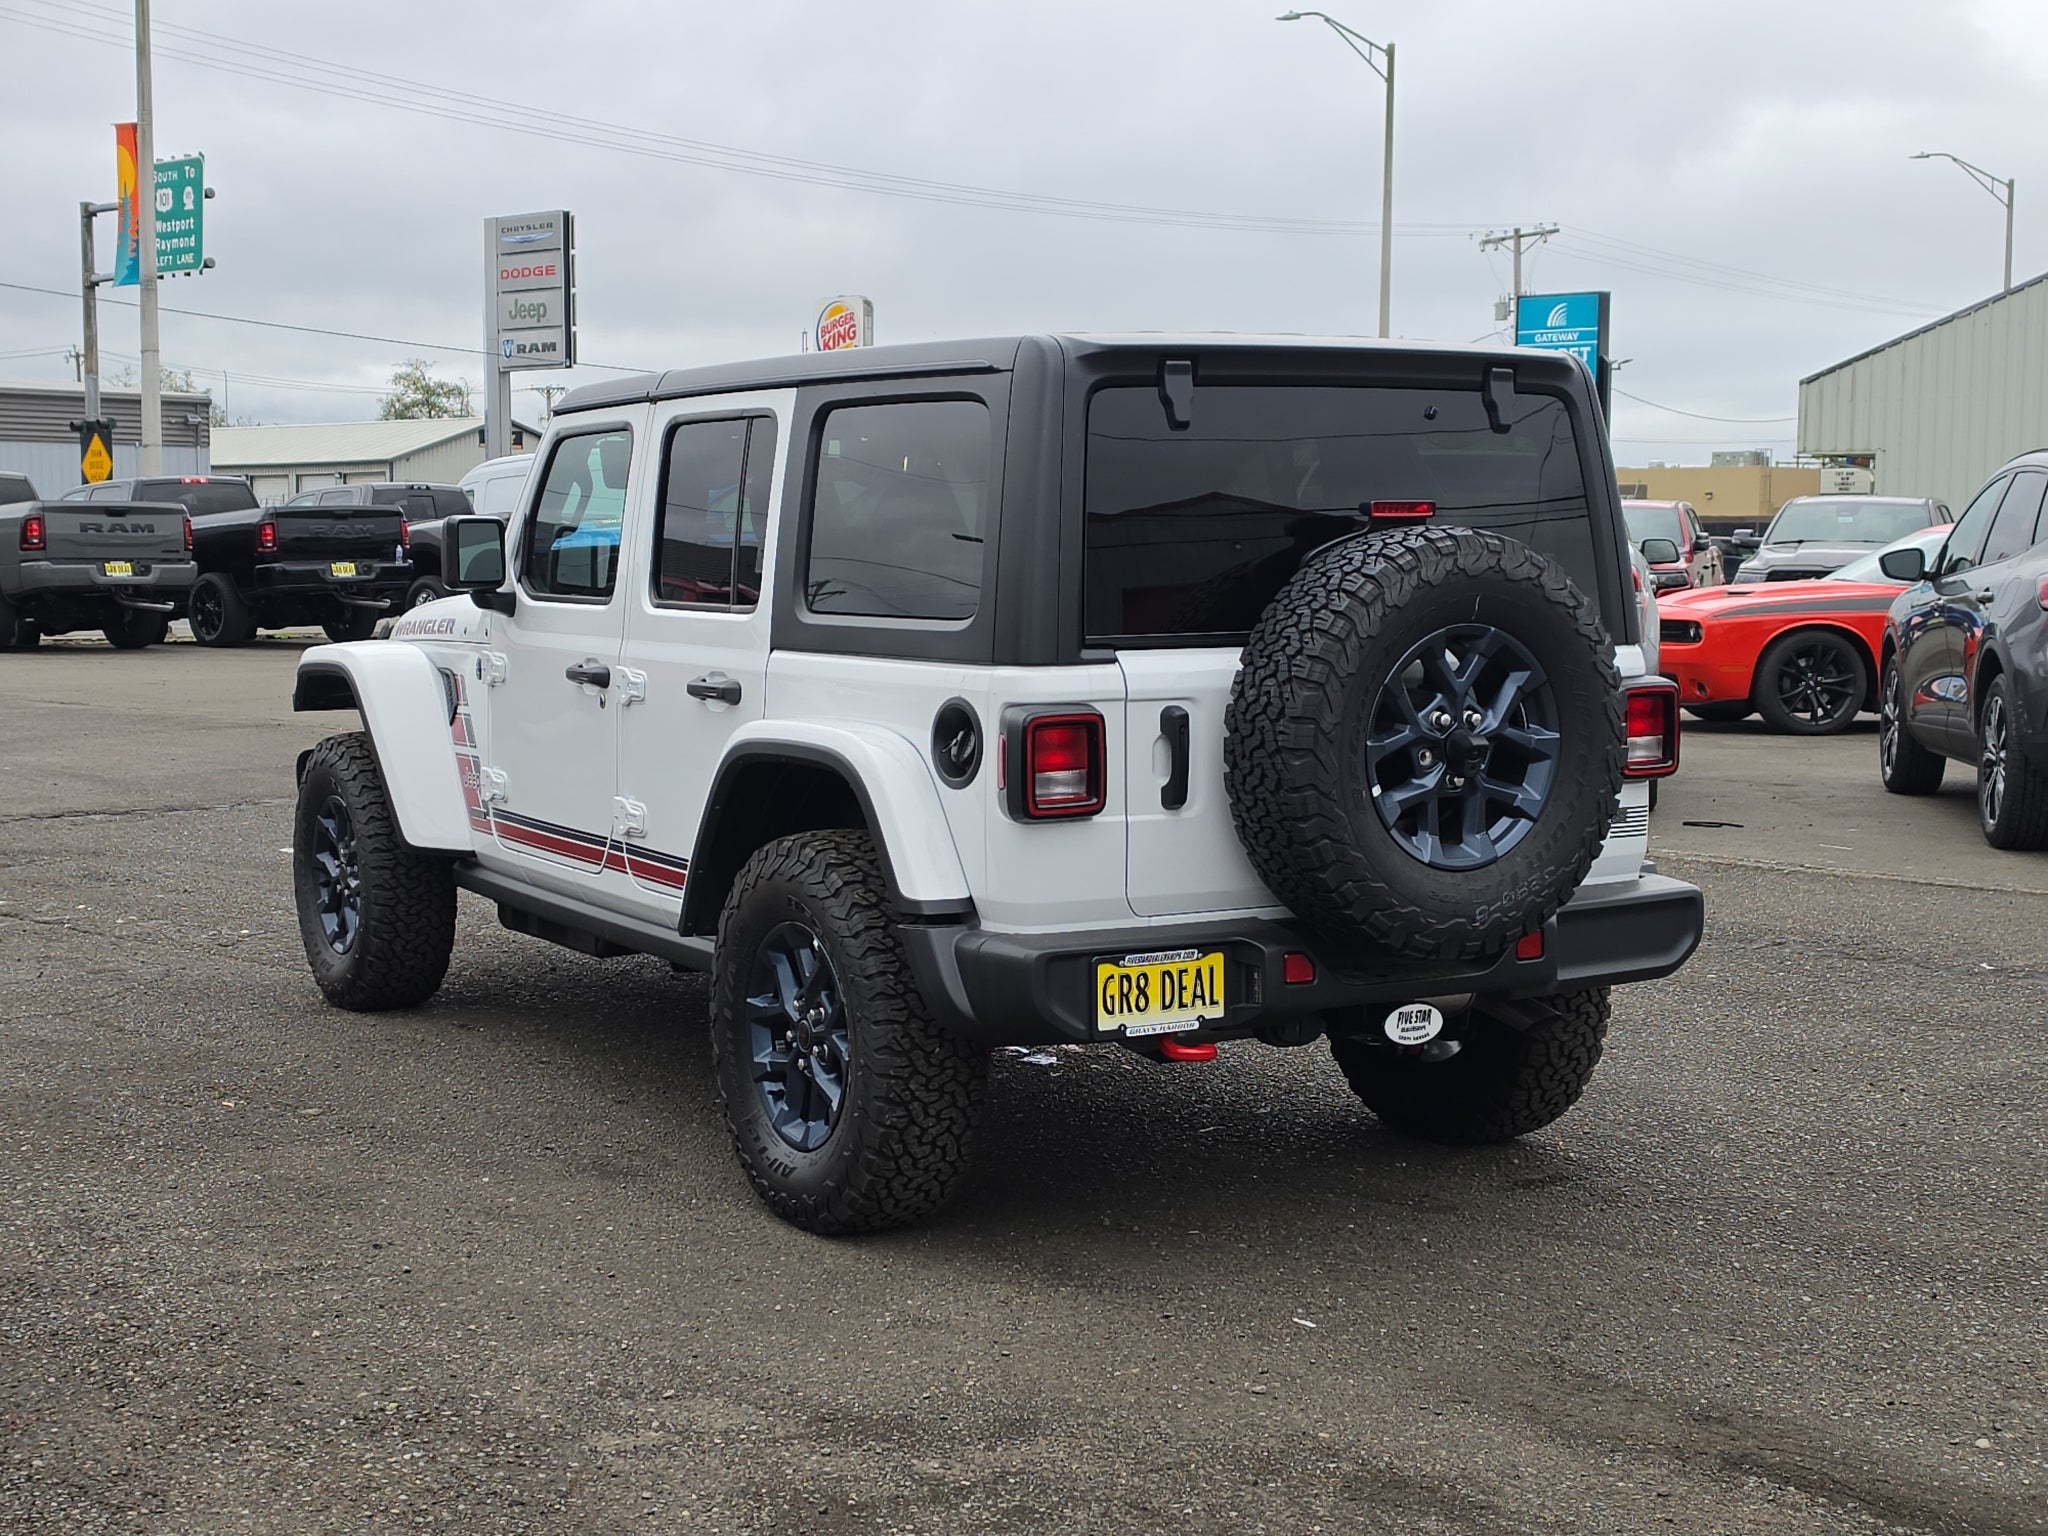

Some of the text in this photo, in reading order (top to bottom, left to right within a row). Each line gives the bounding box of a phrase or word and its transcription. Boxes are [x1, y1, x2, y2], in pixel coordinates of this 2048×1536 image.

[153, 166, 195, 184] SOUTH To
[159, 191, 170, 206] 101
[156, 217, 194, 234] Westport
[500, 221, 554, 234] CHRYSLER
[156, 234, 195, 253] Raymond
[156, 253, 194, 266] LEFT LANE
[500, 264, 556, 280] DODGE
[508, 297, 548, 322] Jeep
[820, 311, 856, 339] BURGER
[822, 323, 857, 351] KING
[1535, 331, 1580, 343] GATEWAY
[516, 341, 557, 354] RAM
[79, 522, 155, 534] RAM
[308, 524, 375, 537] RAM
[395, 618, 456, 636] WRANGLER
[1102, 965, 1219, 1016] GR8 DEAL
[1396, 1010, 1414, 1030] FIVE
[1414, 1008, 1433, 1026] STAR
